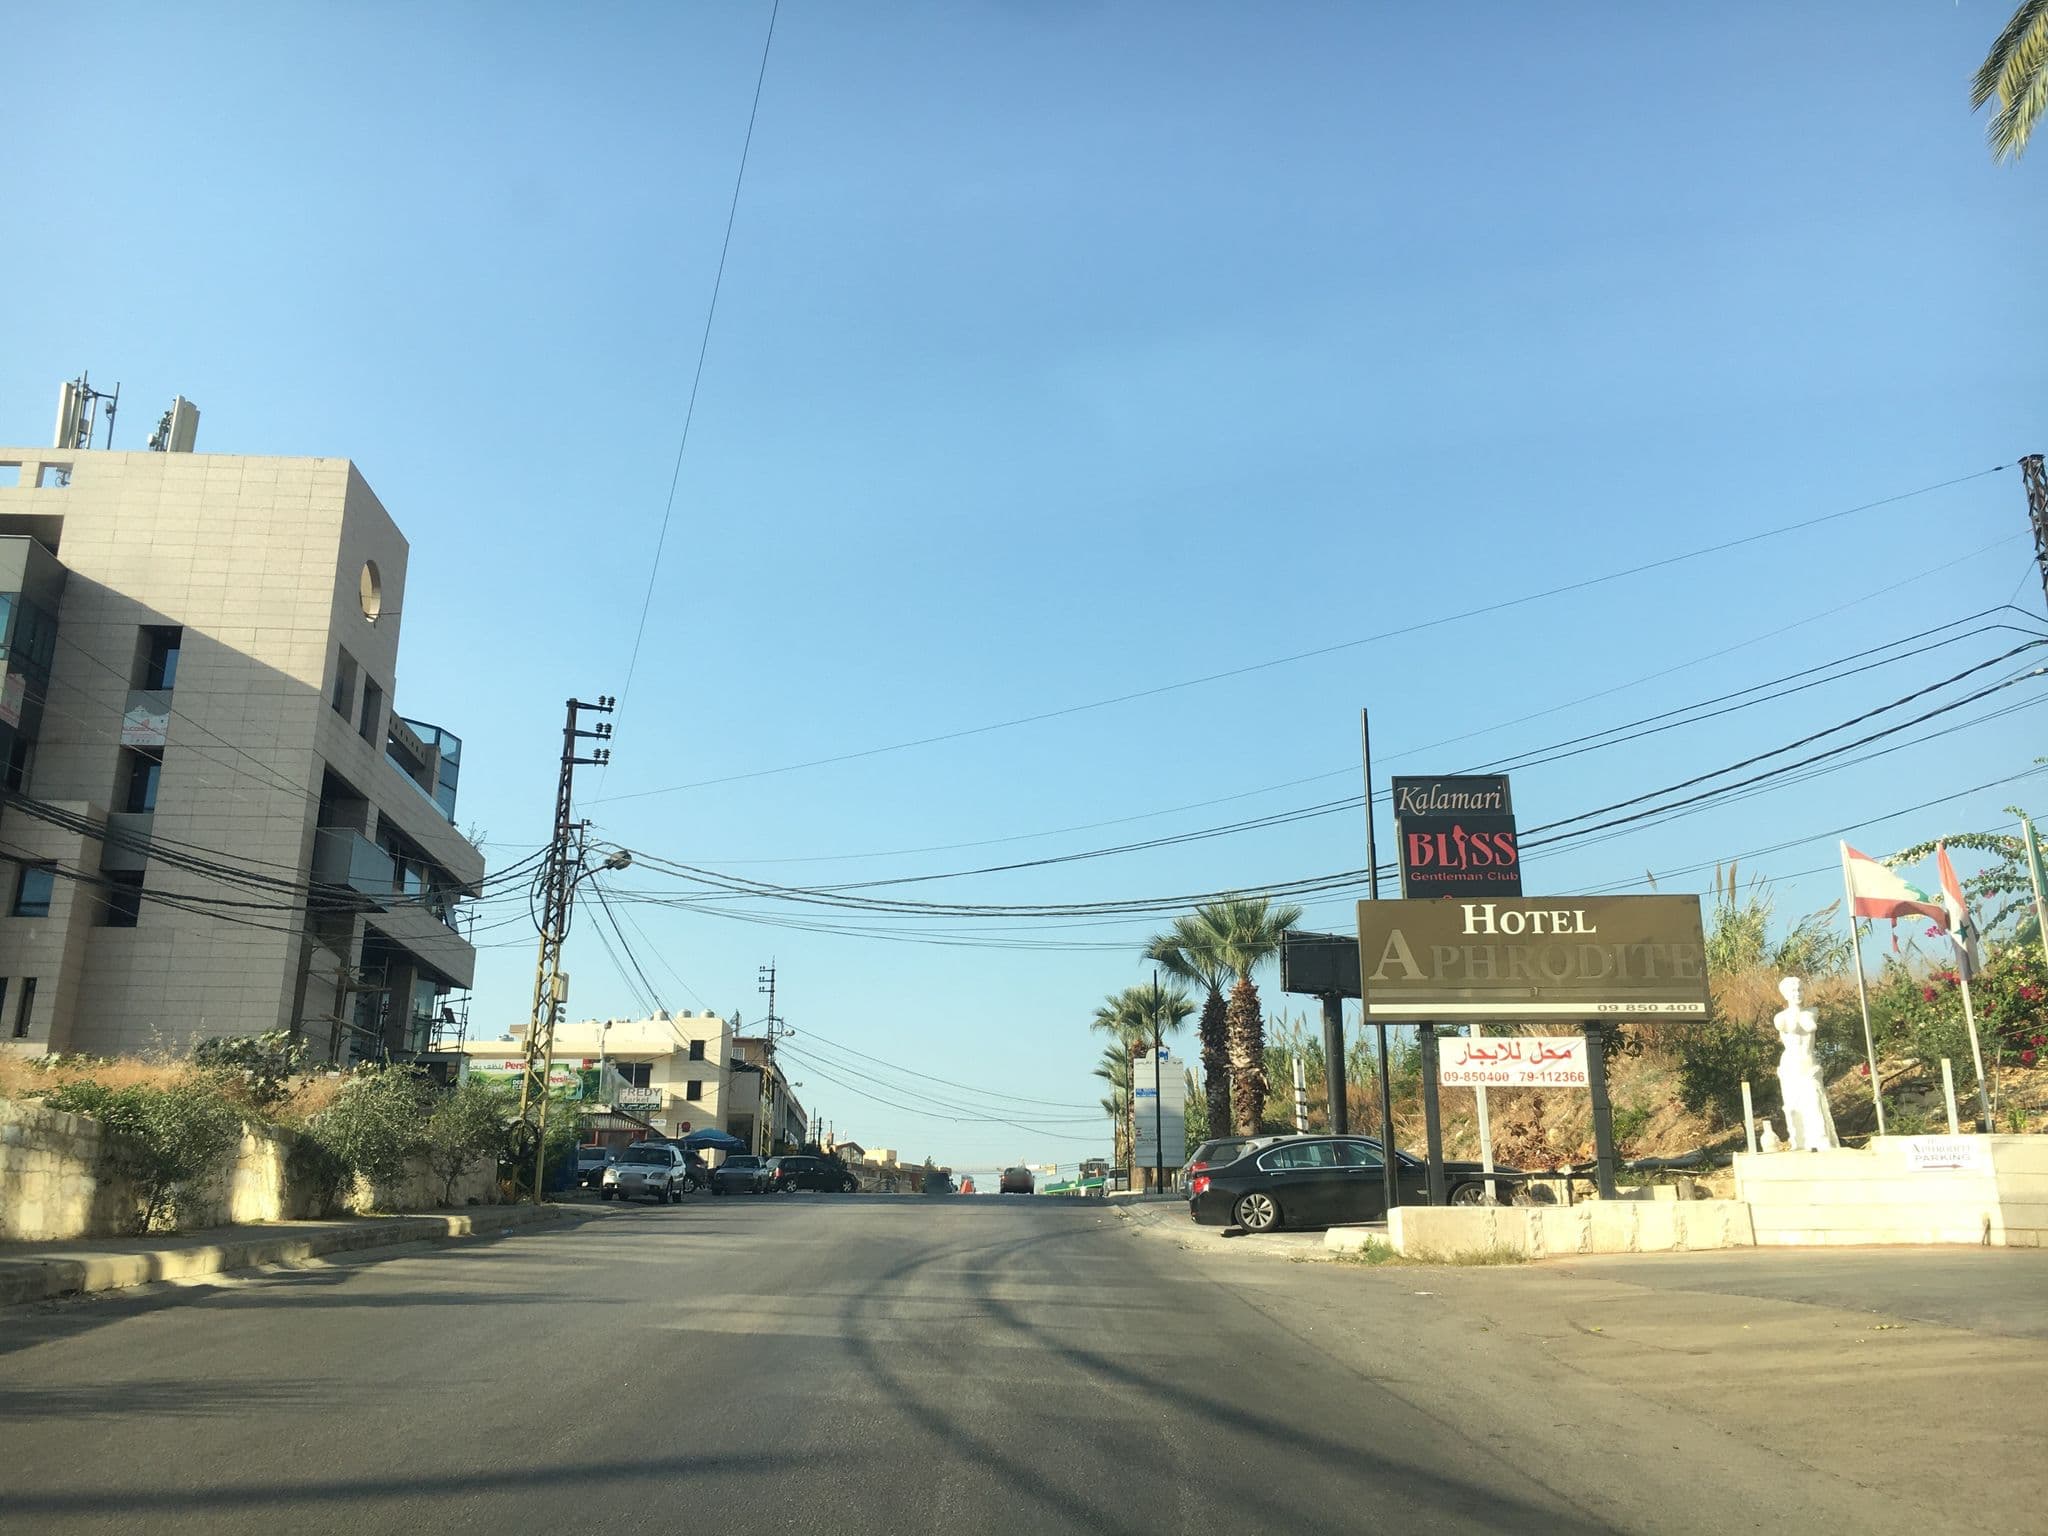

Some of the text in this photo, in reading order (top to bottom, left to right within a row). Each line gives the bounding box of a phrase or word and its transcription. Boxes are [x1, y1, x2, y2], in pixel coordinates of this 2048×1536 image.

[1397, 784, 1502, 816] Kalamari
[1411, 872, 1518, 881] Gentleman Club
[1369, 929, 1701, 981] APHRODITE
[1598, 1003, 1699, 1012] 09 850 400
[1530, 1042, 1572, 1064] محل
[1444, 1072, 1585, 1082] 09-850400 79-112366
[621, 1088, 661, 1096] FREDY
